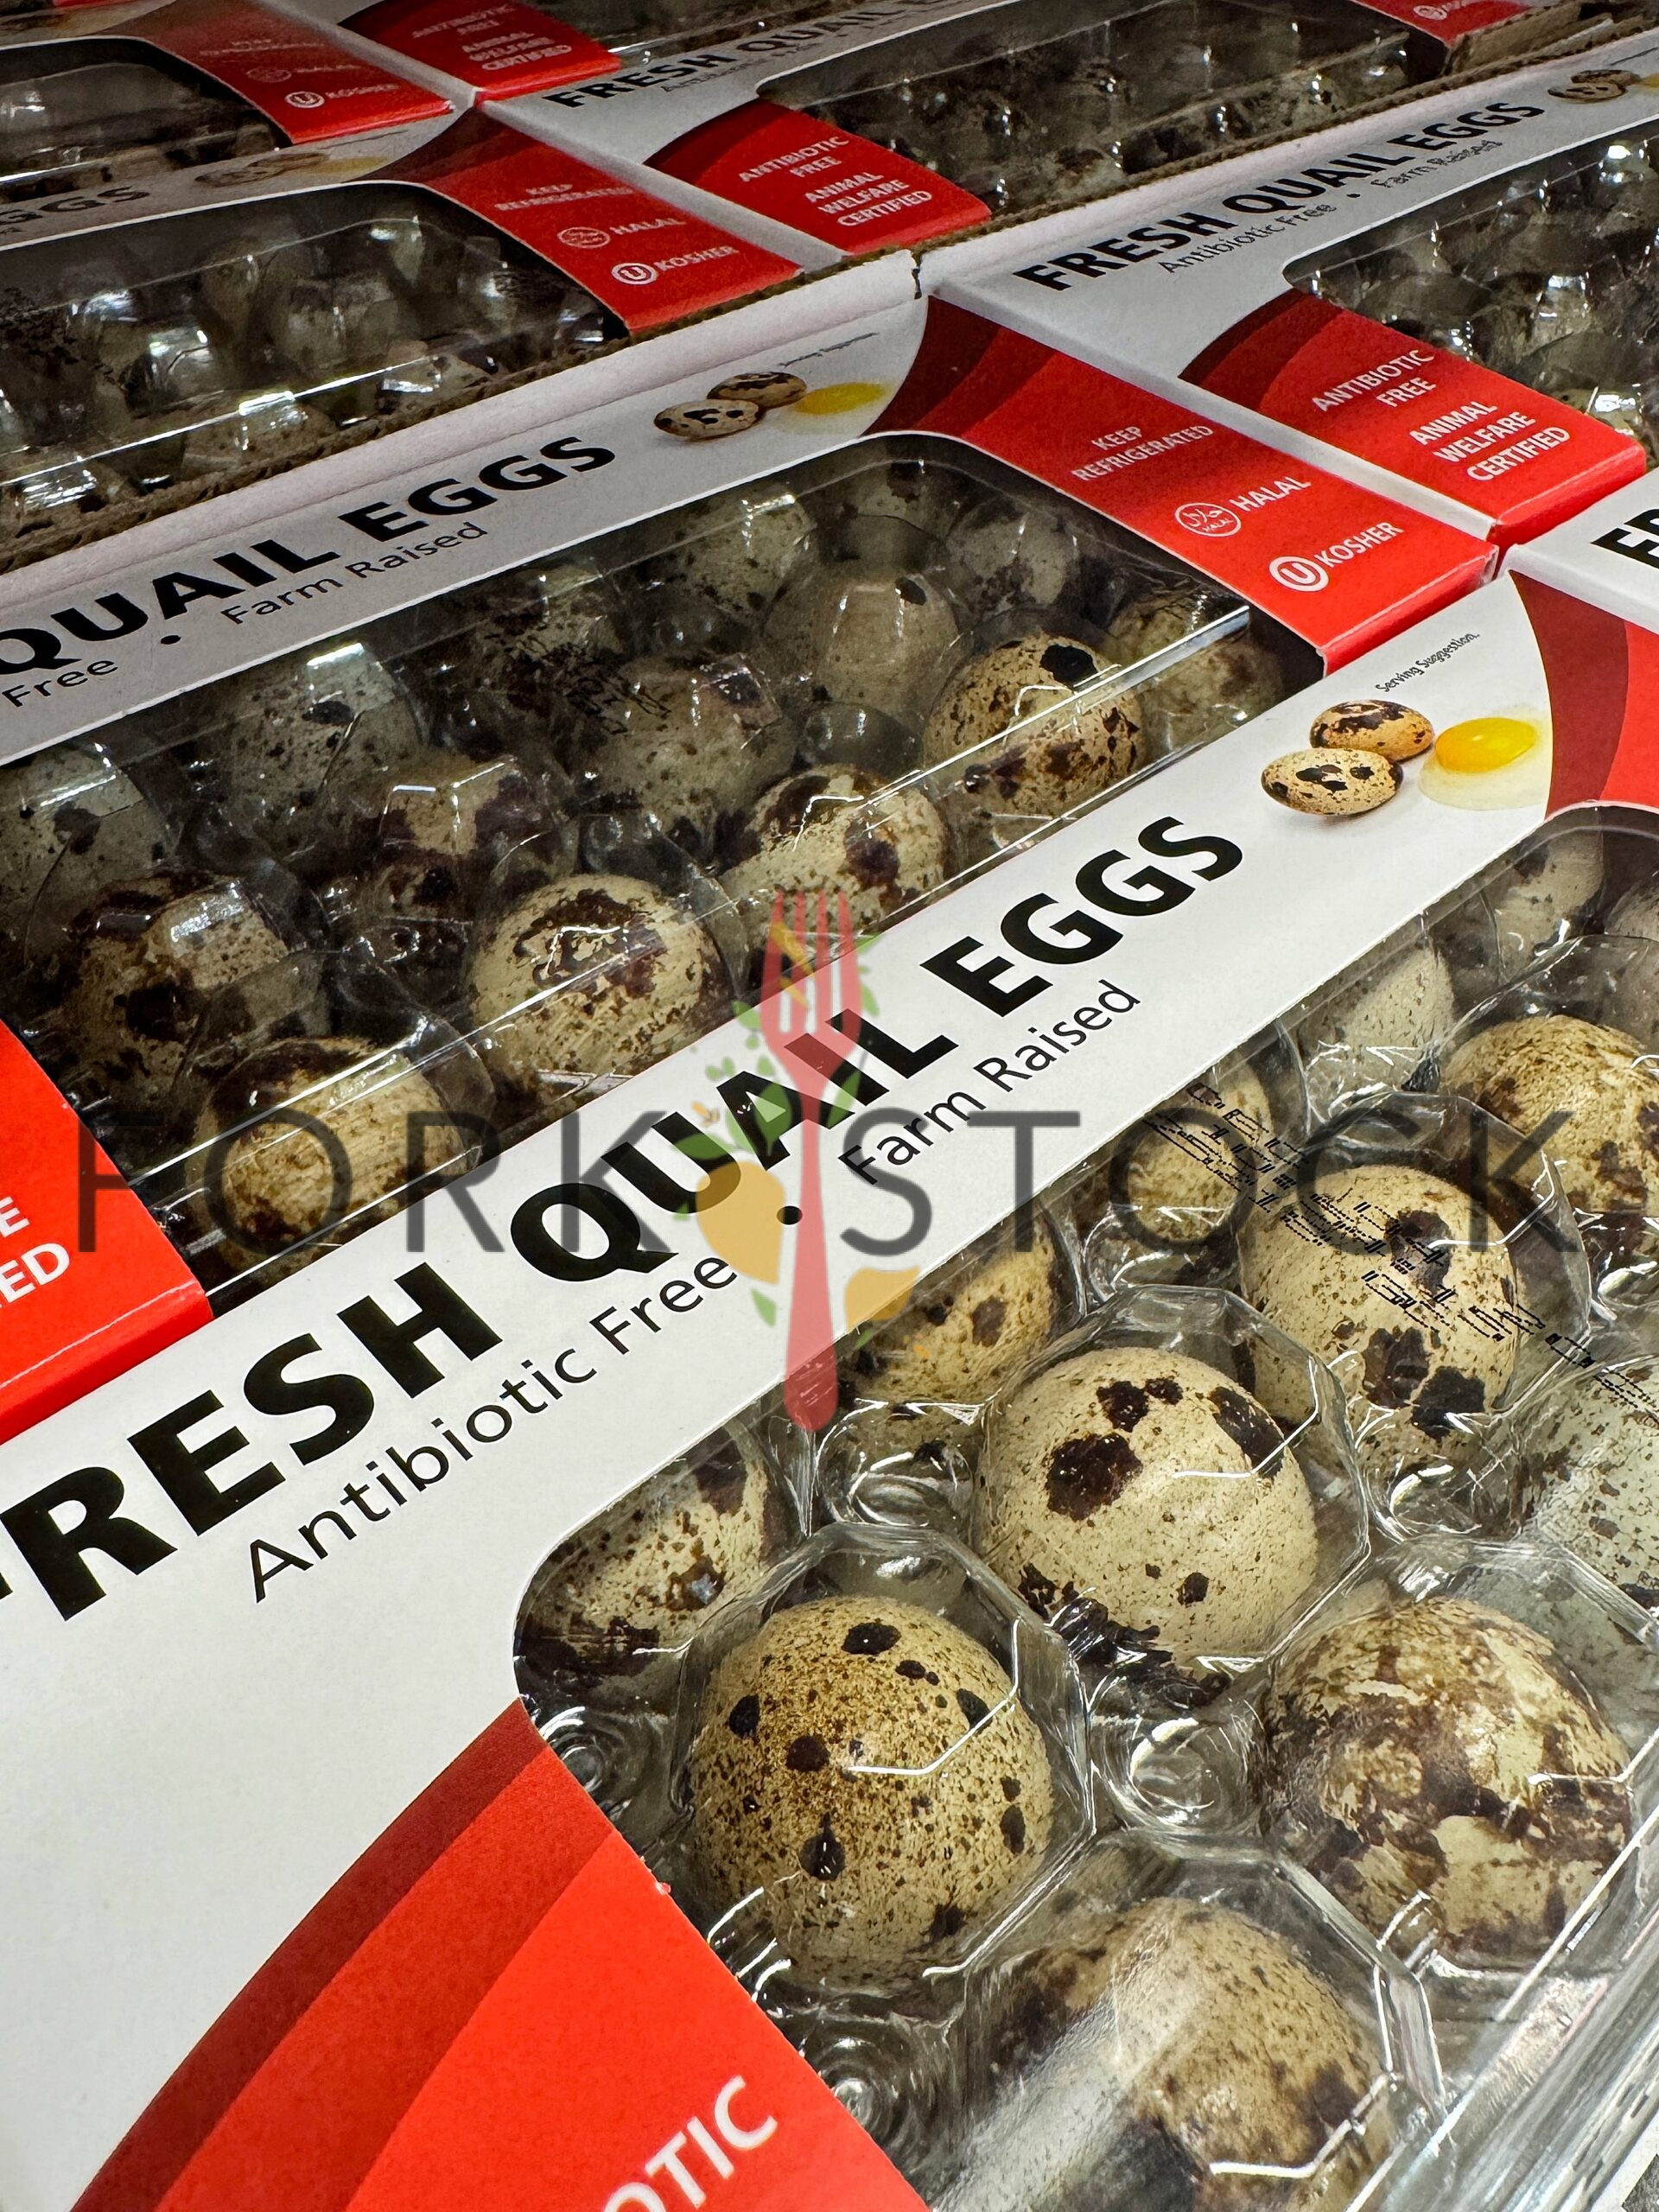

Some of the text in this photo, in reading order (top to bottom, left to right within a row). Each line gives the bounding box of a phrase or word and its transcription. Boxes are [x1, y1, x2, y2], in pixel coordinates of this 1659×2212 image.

[542, 54, 737, 108] FRESH
[739, 136, 849, 182] ANTIBIOTIC
[790, 156, 842, 178] FREE
[804, 172, 885, 203] ANIMAL
[817, 179, 910, 214] WELFARE
[837, 190, 933, 226] CERTIFIED
[1013, 102, 1546, 291] FRESH QUAIL EGGS
[1158, 139, 1503, 274] Antibiotic Free Farm Raised
[609, 217, 687, 235] HALAL
[653, 245, 740, 271] KOSHER
[1312, 349, 1435, 412] ANTIBIOTIC
[1376, 377, 1437, 408] FREE
[1091, 425, 1143, 451] KEEP
[1409, 401, 1498, 445] ANIMAL
[1433, 411, 1536, 462] WELFARE
[1071, 424, 1214, 481] REFRIGERATED
[1466, 426, 1571, 481] CERTIFIED
[1230, 476, 1312, 512] HALAL
[0, 435, 616, 675] QUAIL EGGS
[1314, 521, 1404, 569] KOSHER
[2, 521, 488, 708] Free Farm Raised
[1375, 665, 1425, 692] Serving
[0, 817, 1243, 1622] RESH QUAIL EGGS
[249, 978, 1141, 1604] Antibiotic Free Farm Raised
